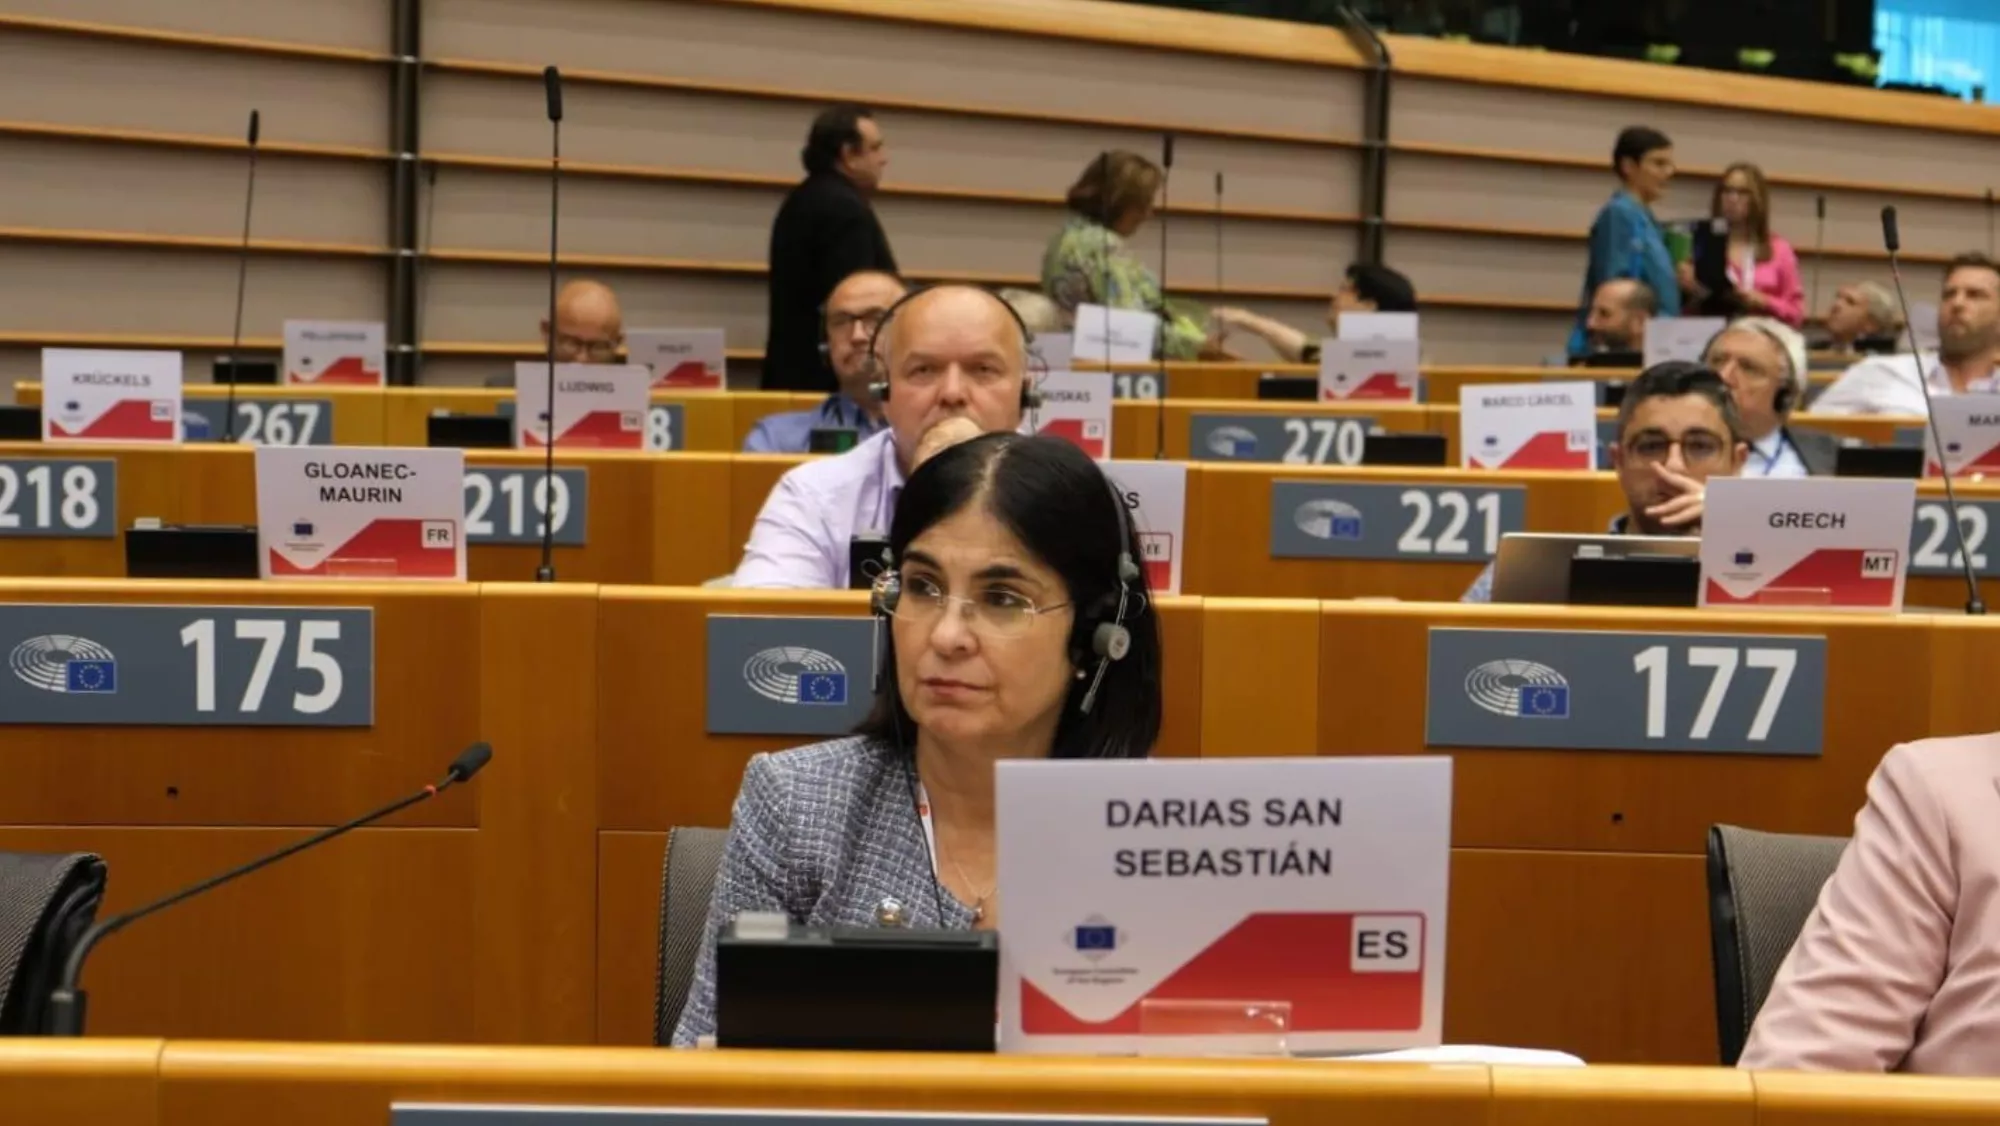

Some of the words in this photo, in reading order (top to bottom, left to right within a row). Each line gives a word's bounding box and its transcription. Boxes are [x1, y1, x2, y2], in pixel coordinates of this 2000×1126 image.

[557, 381, 615, 394] LUDWIG
[237, 403, 320, 445] 267
[1283, 419, 1364, 466] 270
[304, 461, 417, 480] GLOANEC-
[0, 466, 99, 529] 218
[319, 485, 403, 503] MAURIN
[464, 473, 570, 536] 219
[426, 527, 449, 542] FR
[1398, 489, 1500, 554] 221
[1768, 511, 1846, 529] GRECH
[1913, 503, 1987, 569] 22
[1863, 555, 1893, 572] MT
[179, 618, 343, 713] 175
[1633, 646, 1798, 740] 177
[1106, 799, 1251, 828] DARIAS
[1263, 798, 1342, 826] SAN
[1114, 841, 1333, 877] SEBASTIÁN
[1356, 930, 1409, 959] ES
